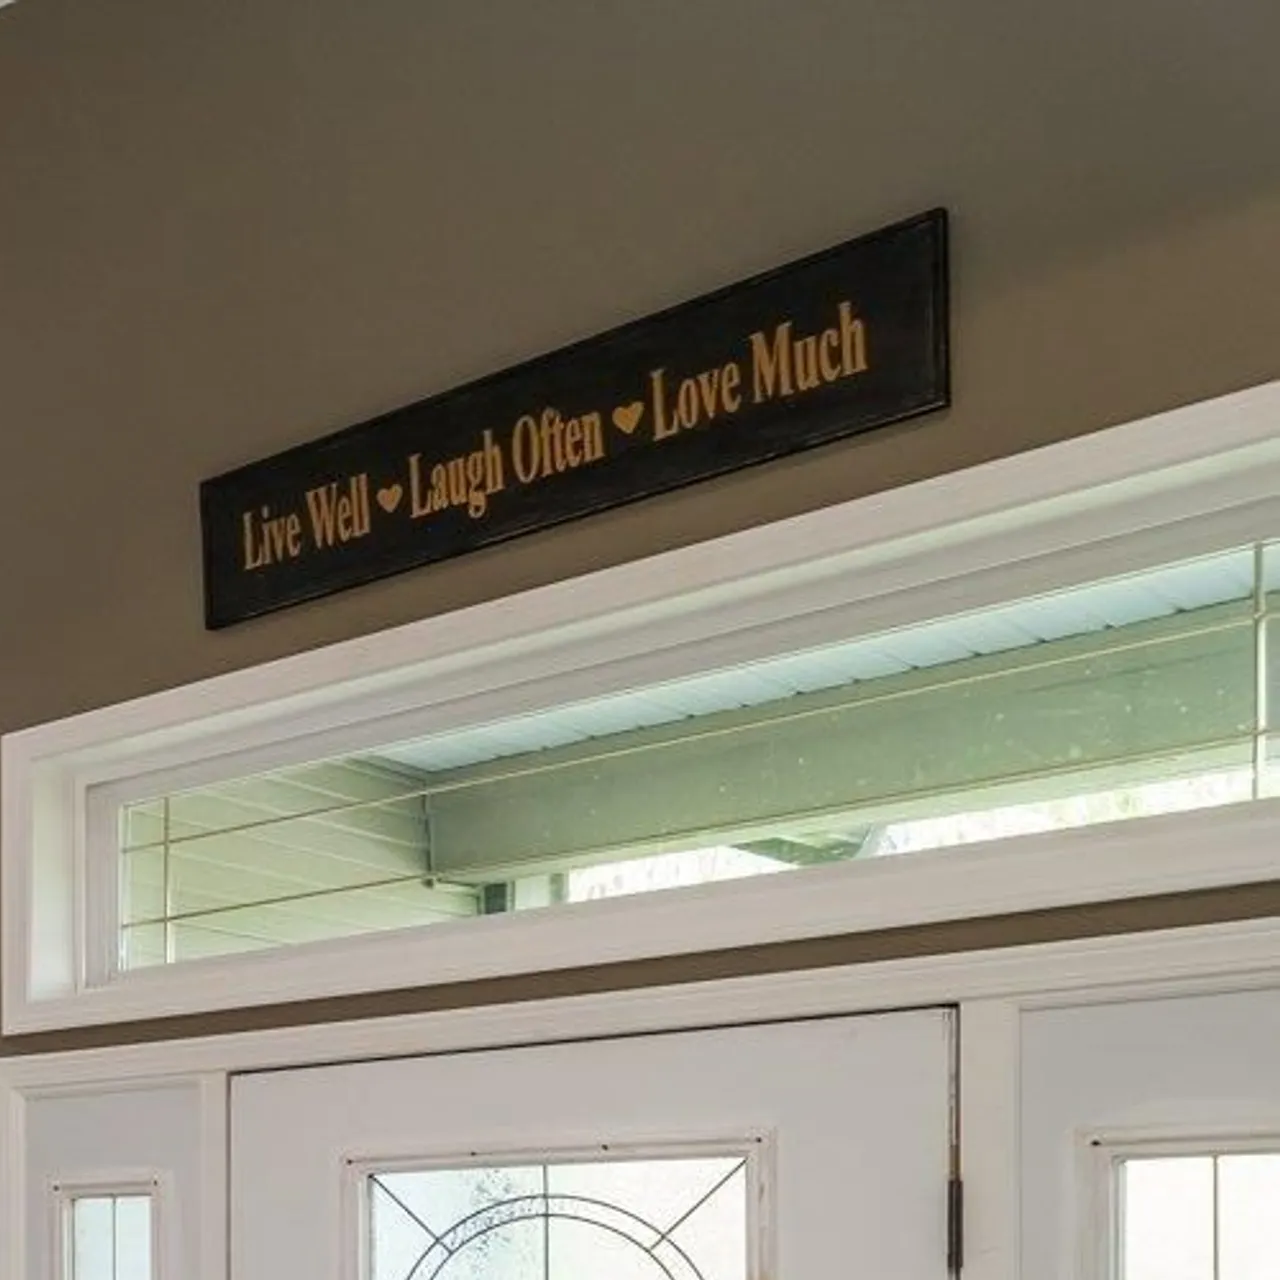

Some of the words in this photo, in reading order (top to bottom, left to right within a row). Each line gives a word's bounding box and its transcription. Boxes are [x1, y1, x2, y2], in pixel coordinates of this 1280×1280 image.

[243, 510, 301, 570] Live
[306, 473, 370, 549] Well
[409, 430, 504, 518] Laugh
[512, 406, 605, 484] Often
[651, 363, 740, 441] Love
[750, 302, 868, 404] Much
